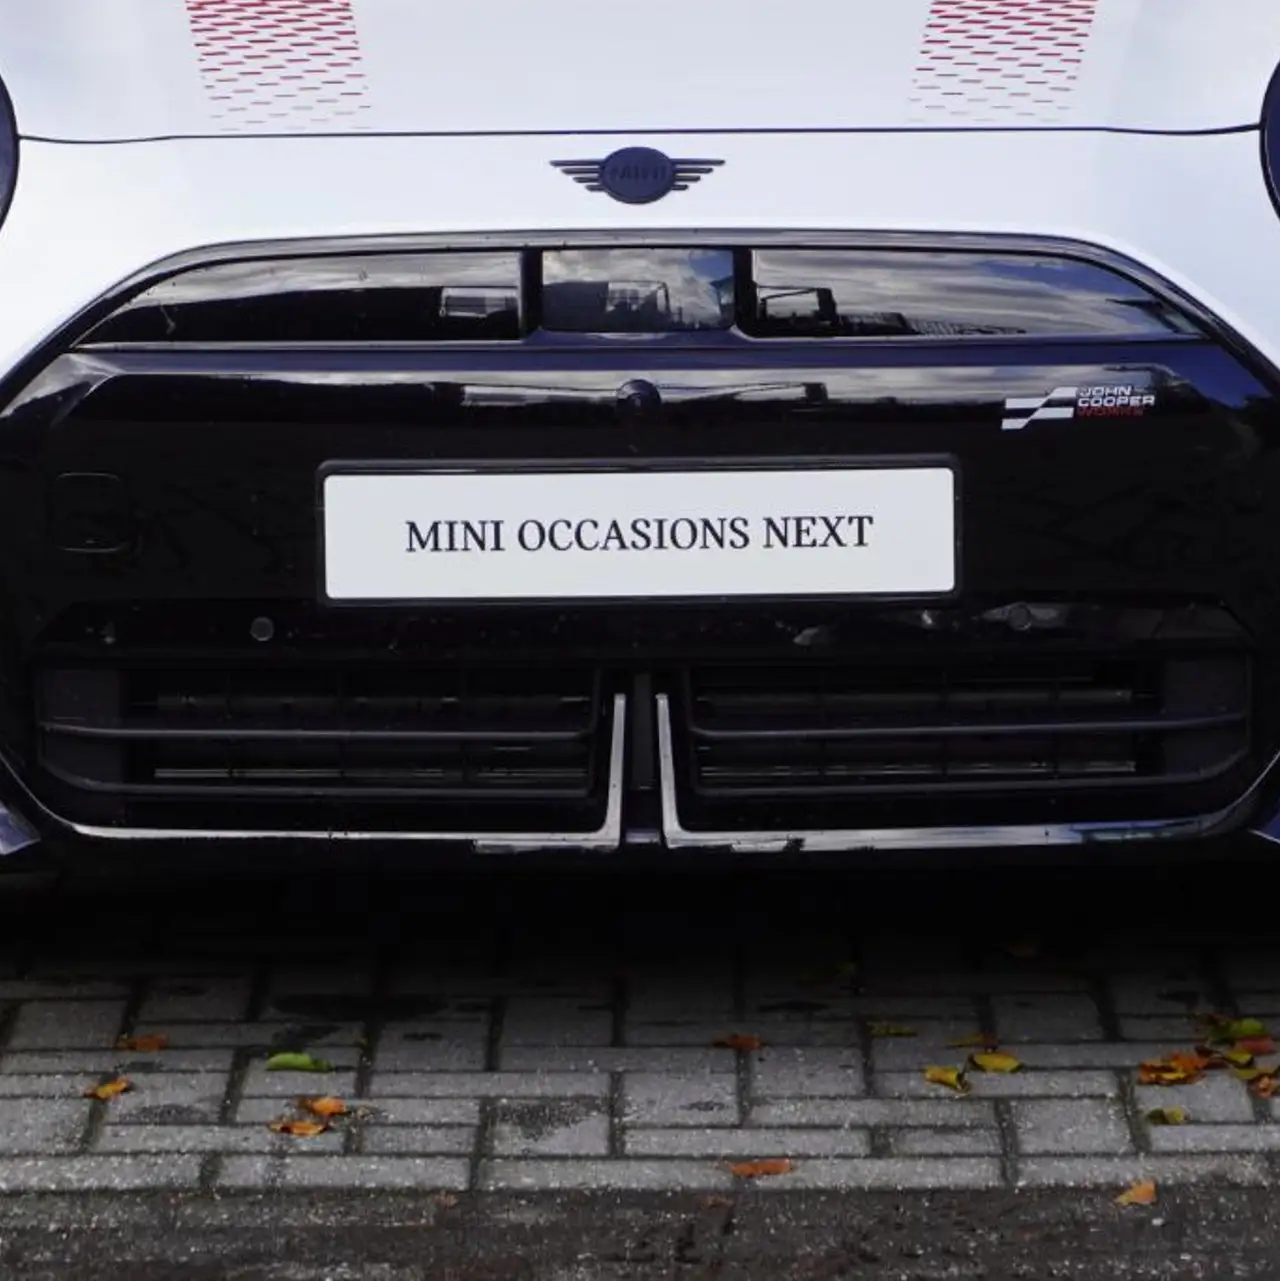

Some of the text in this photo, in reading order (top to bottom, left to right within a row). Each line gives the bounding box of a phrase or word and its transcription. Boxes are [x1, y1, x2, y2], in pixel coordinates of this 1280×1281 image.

[1079, 385, 1132, 397] JOHN
[1077, 395, 1155, 408] COOPER
[405, 514, 875, 553] MINI OCCASIONS NEXT
